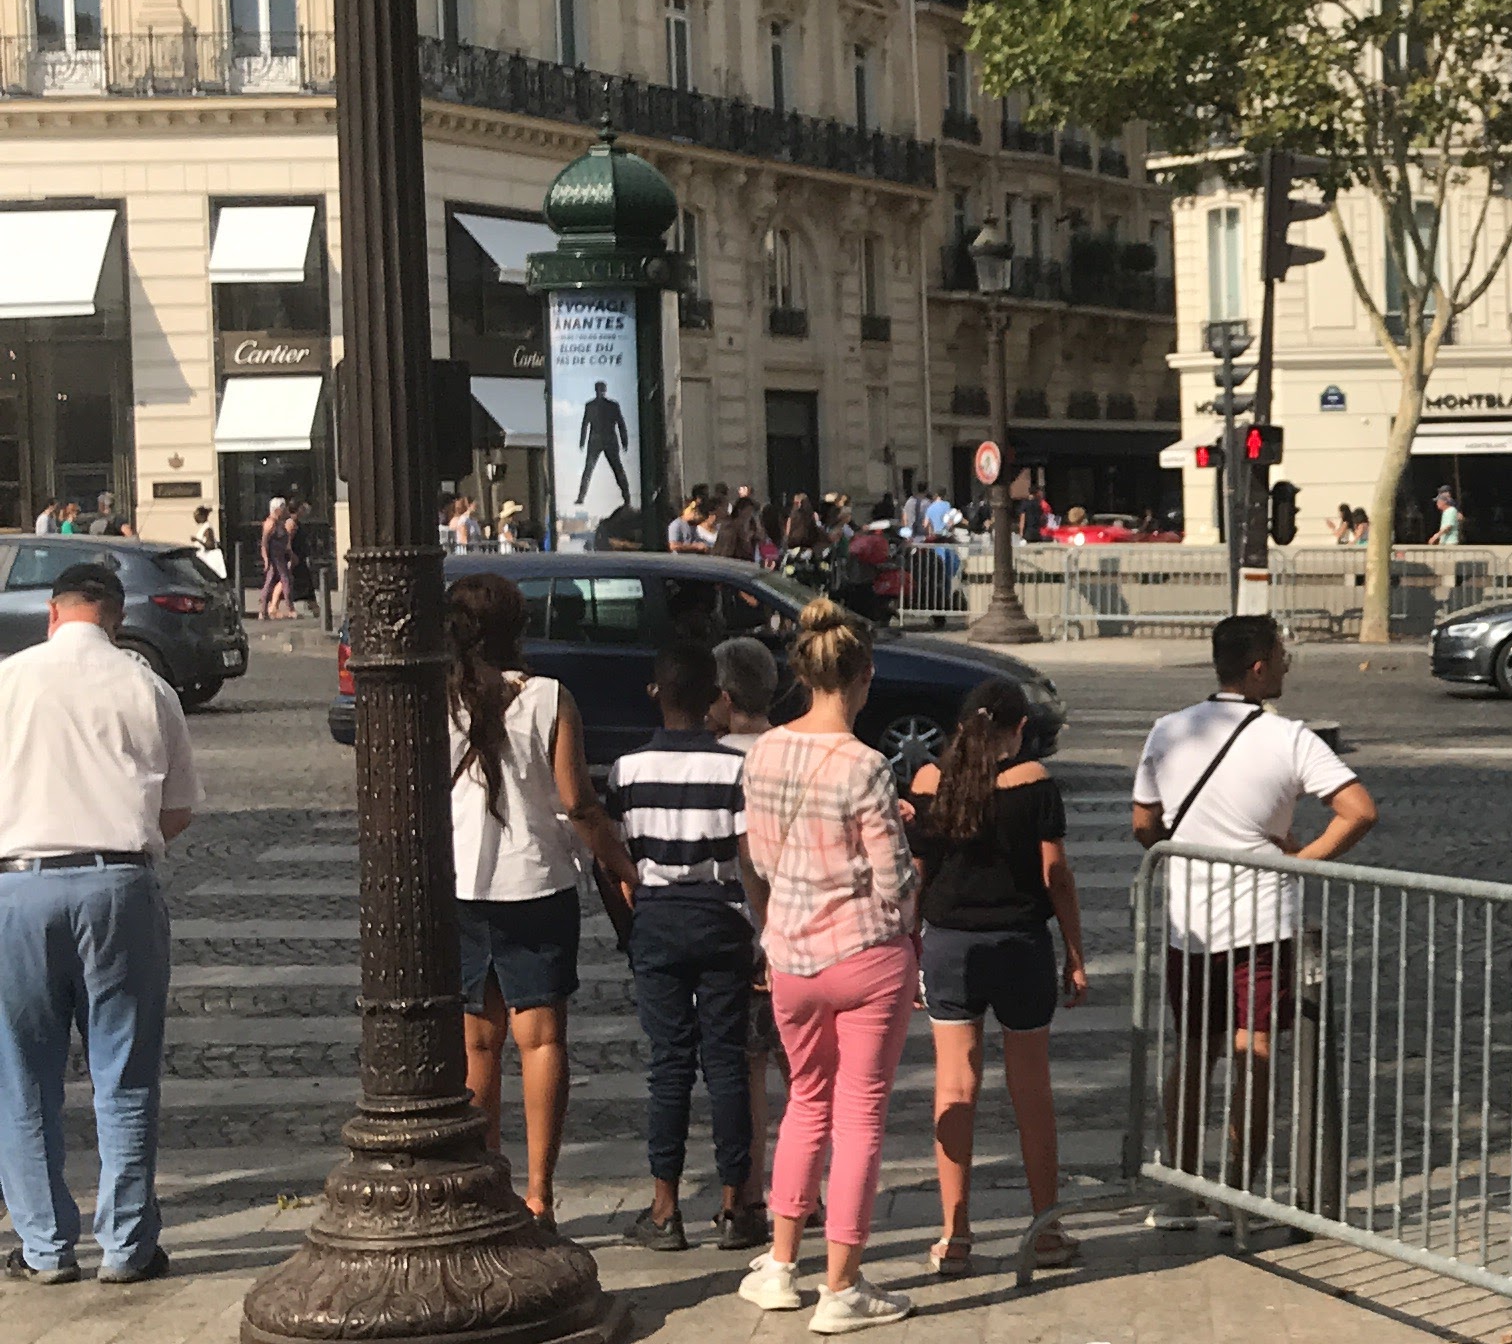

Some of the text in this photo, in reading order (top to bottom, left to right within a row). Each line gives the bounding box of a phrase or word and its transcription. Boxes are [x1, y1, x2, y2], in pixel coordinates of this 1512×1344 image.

[566, 299, 628, 314] VOYAGE
[563, 316, 625, 330] NANTES
[234, 339, 310, 365] Cartier
